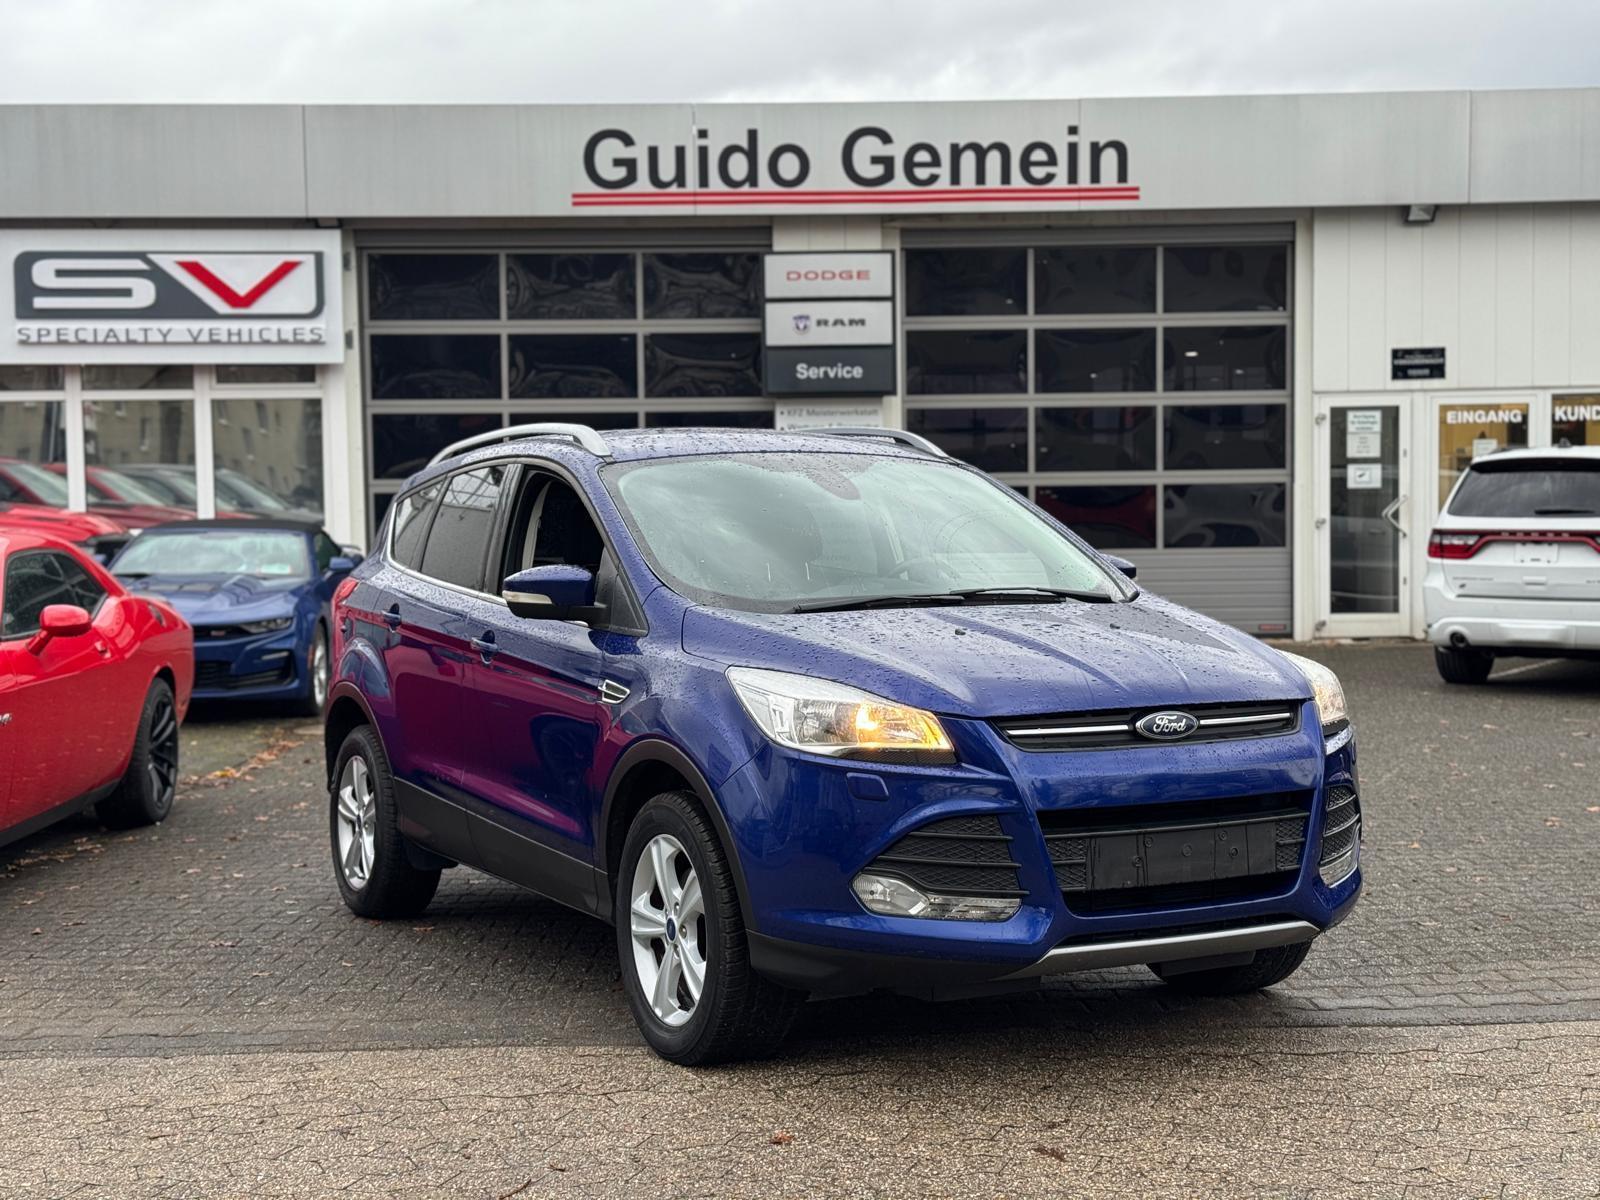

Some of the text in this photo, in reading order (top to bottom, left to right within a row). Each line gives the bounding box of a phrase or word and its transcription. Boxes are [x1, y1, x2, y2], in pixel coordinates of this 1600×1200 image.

[583, 125, 1129, 190] Guido Gemein
[786, 270, 870, 281] DODGE
[816, 318, 866, 327] RAM
[17, 327, 325, 343] SPECIALTY VEHICLES
[795, 363, 864, 380] Service
[1446, 409, 1522, 424] EINGANG
[1153, 715, 1187, 733] Ford
